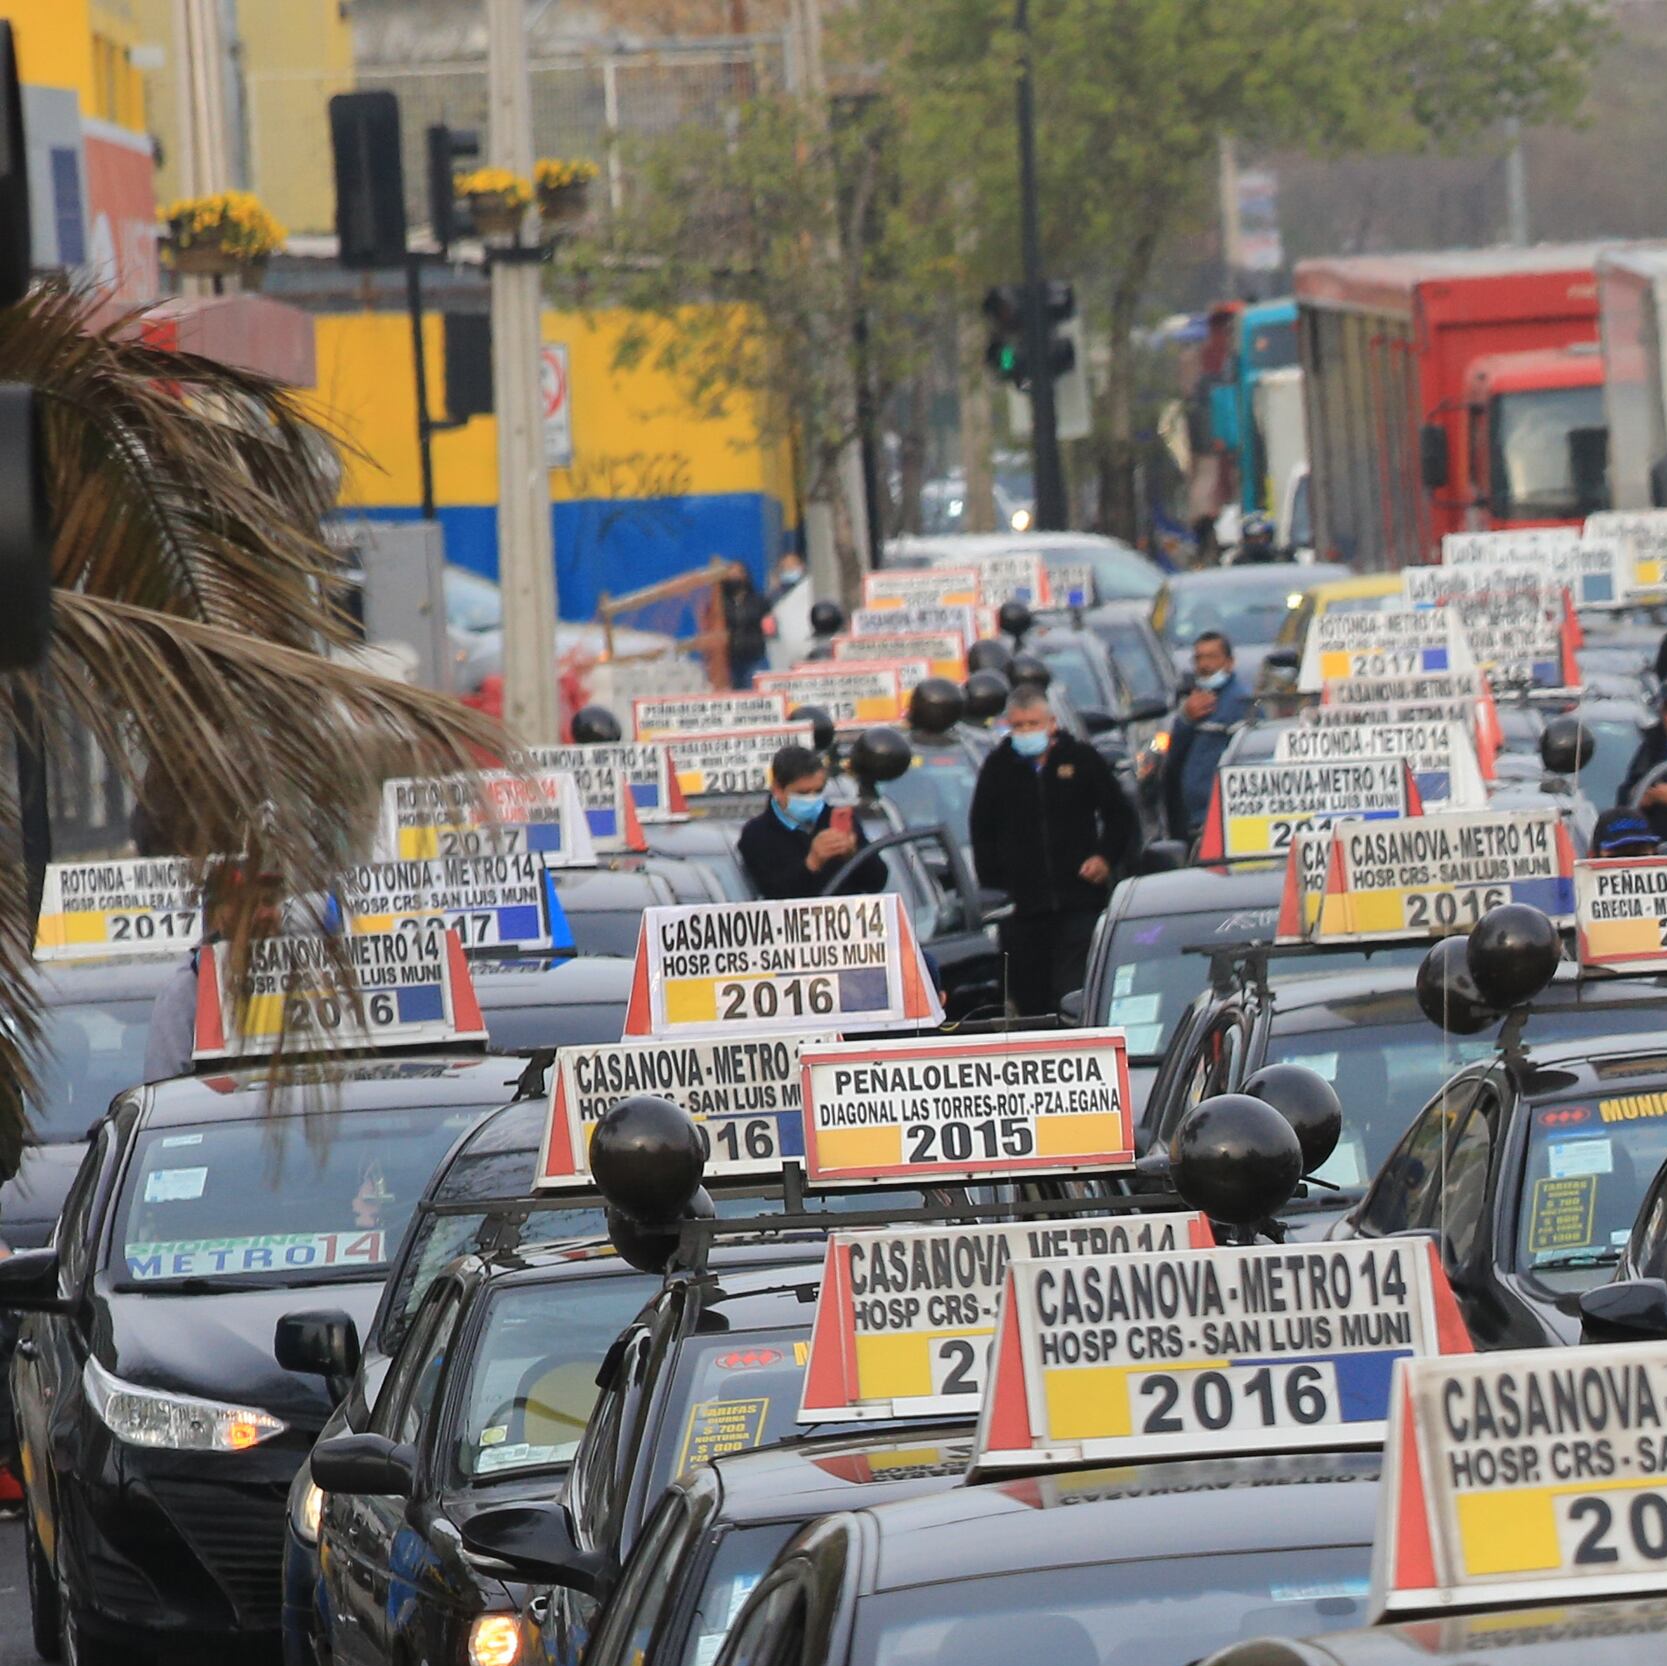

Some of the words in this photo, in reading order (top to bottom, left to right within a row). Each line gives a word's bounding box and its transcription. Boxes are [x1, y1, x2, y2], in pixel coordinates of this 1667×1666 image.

[1353, 652, 1416, 676] 2017
[1430, 727, 1448, 749] 14
[641, 747, 657, 767] 14
[596, 767, 614, 787] 14
[704, 769, 766, 792] 2015
[1379, 765, 1398, 789] 14
[1522, 820, 1547, 853] 14
[512, 854, 535, 884] 14
[1399, 867, 1429, 885] CRS
[1440, 864, 1470, 883] SAN
[1477, 860, 1510, 879] LUIS
[1514, 857, 1551, 876] MUNI
[464, 888, 497, 906] LUIS
[502, 886, 537, 904] MUNI
[1591, 900, 1643, 919] GRECIA
[111, 912, 196, 941] 2017
[856, 901, 884, 939] 14
[412, 930, 440, 962] 14
[663, 956, 711, 977] HOSP.
[715, 952, 750, 973] CRS
[760, 949, 796, 970] SAN
[800, 945, 839, 968] LUIS
[842, 942, 886, 964] MUNI
[362, 965, 397, 986] LUIS
[401, 962, 442, 984] MUNI
[721, 977, 835, 1020] 2016
[688, 1088, 731, 1114] SAN
[734, 1084, 777, 1109] LUIS
[820, 1103, 898, 1127] DIAGONAL
[902, 1101, 930, 1122] LAS
[906, 1117, 1034, 1163] 2015
[127, 1246, 317, 1276] METRO
[1360, 1249, 1406, 1303] 14
[853, 1297, 920, 1331] HOSP
[928, 1293, 979, 1325] CRS
[1041, 1330, 1117, 1365] HOSP
[1128, 1325, 1183, 1360] CRS
[1203, 1320, 1263, 1355] SAN
[1269, 1314, 1333, 1350] LUIS
[1341, 1311, 1412, 1347] MUNI
[1139, 1365, 1327, 1435] 2016
[1450, 1446, 1540, 1488] HOSP.
[1551, 1440, 1614, 1479] CRS
